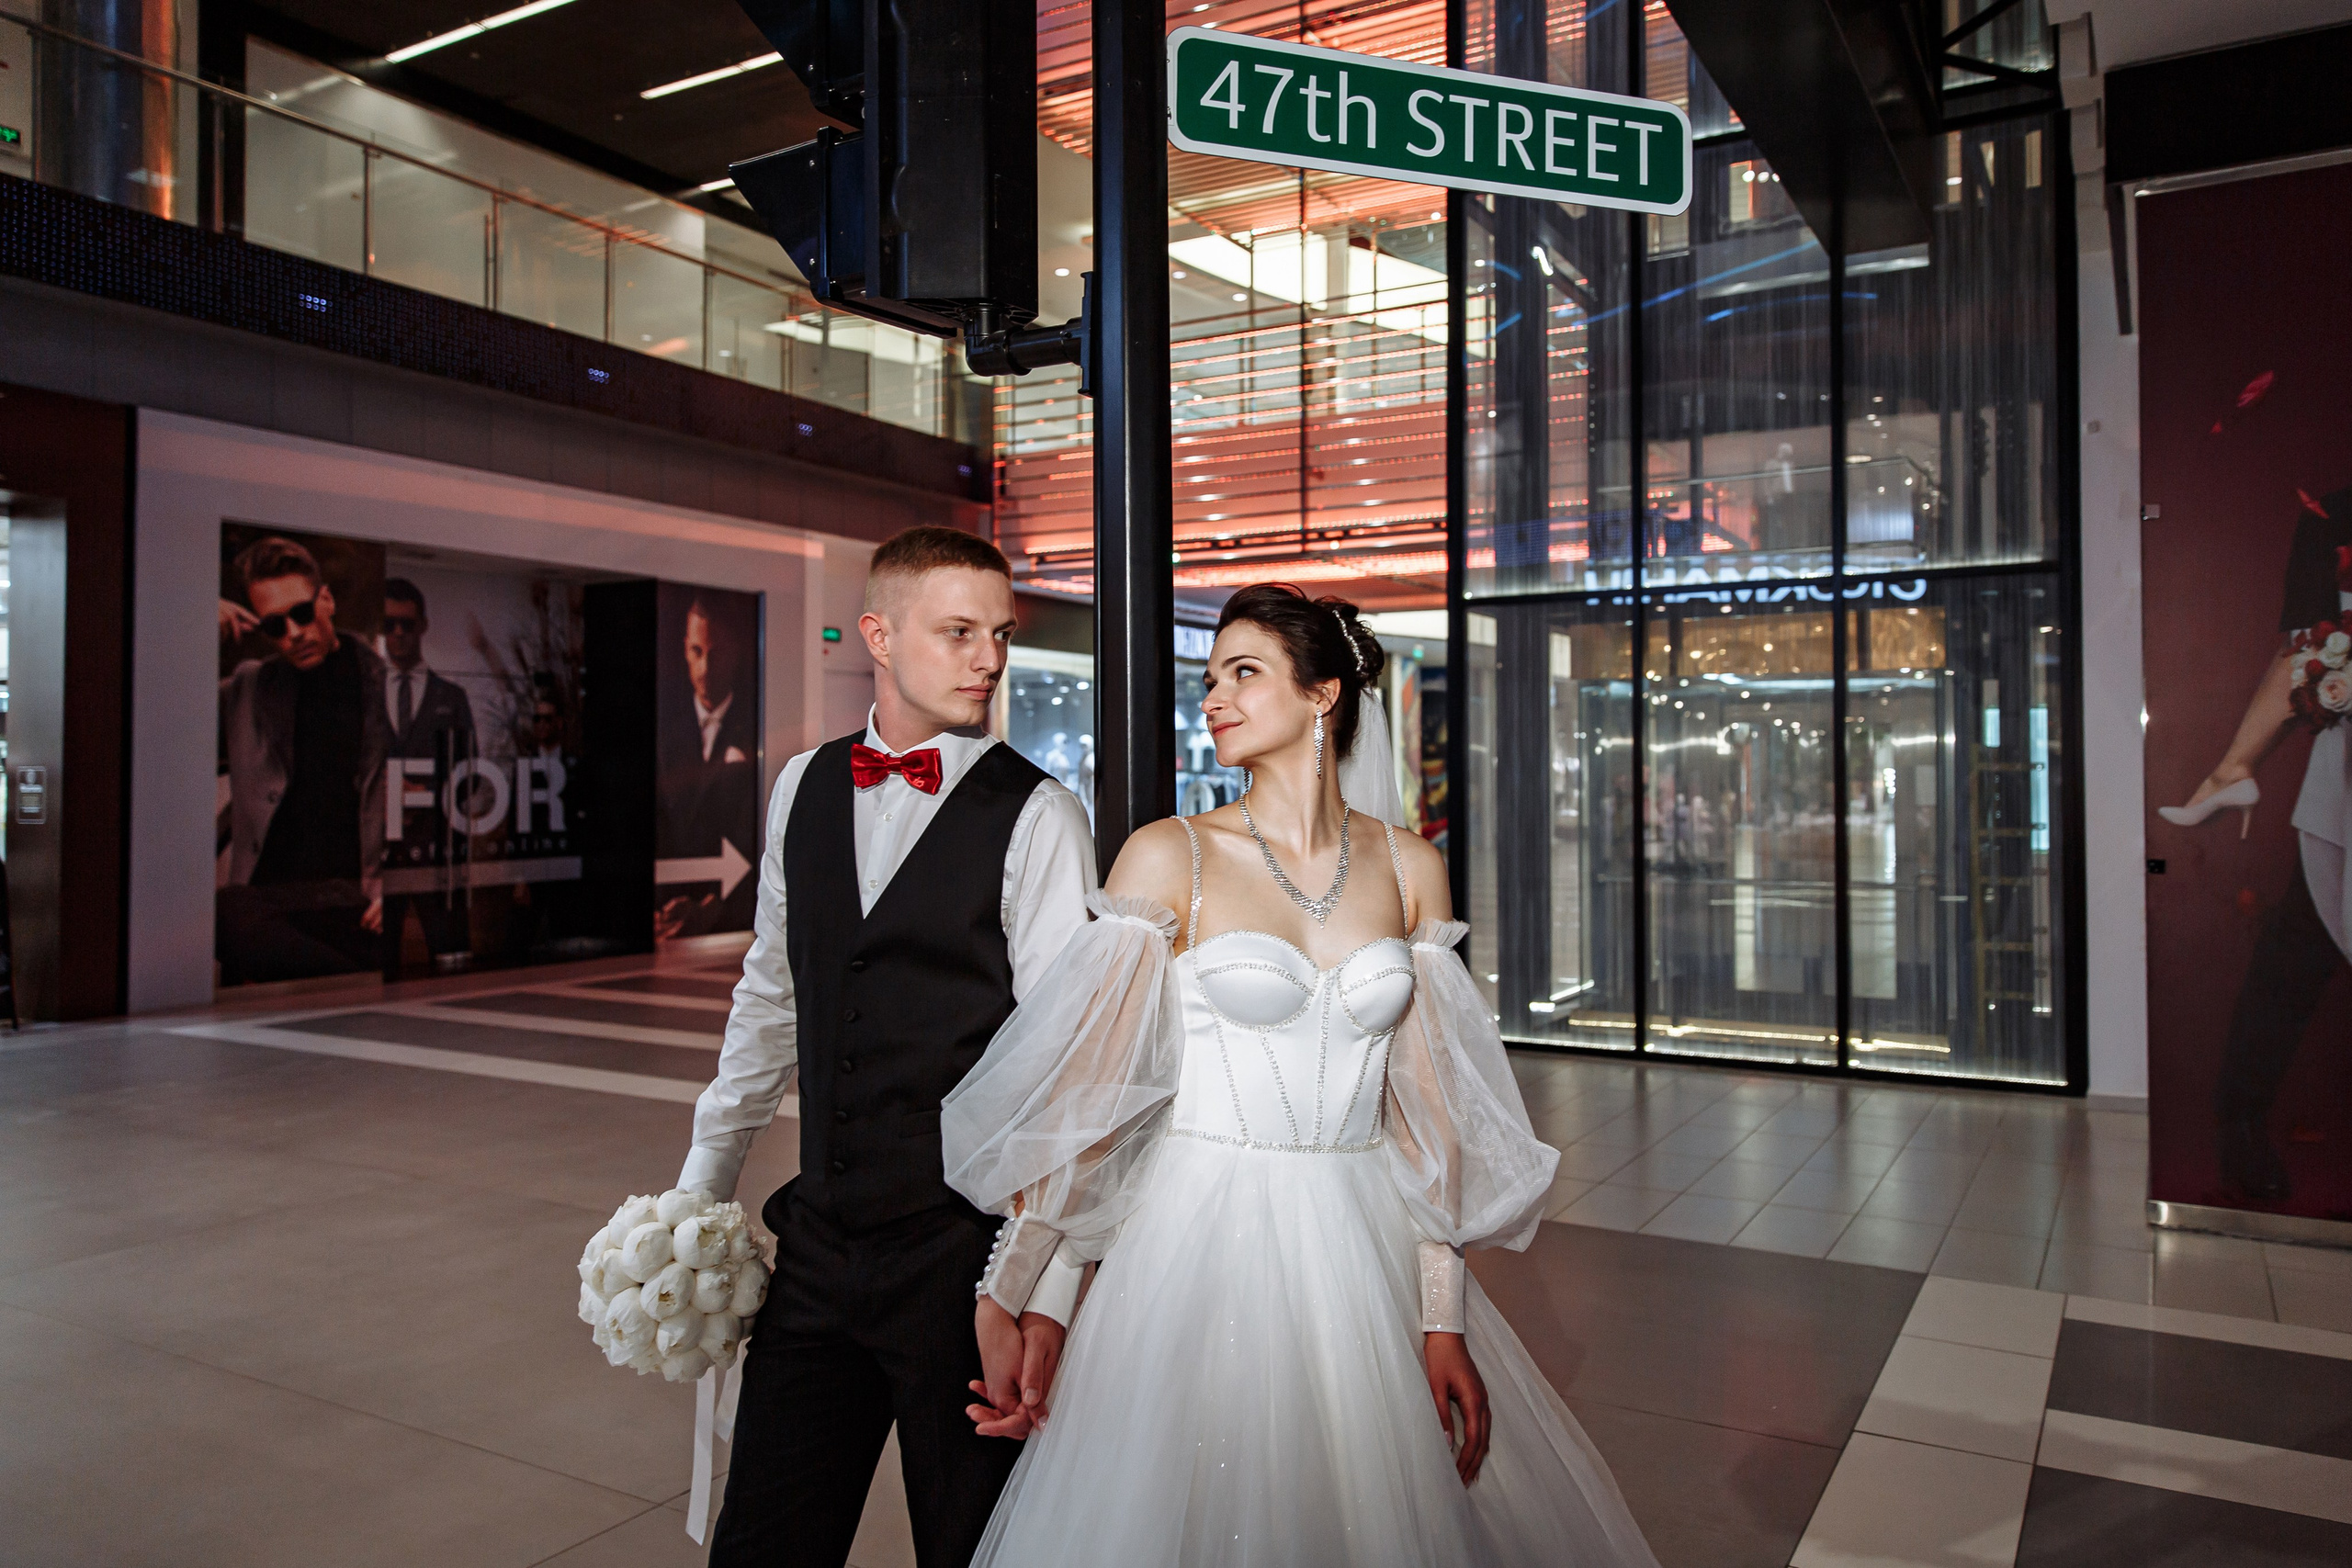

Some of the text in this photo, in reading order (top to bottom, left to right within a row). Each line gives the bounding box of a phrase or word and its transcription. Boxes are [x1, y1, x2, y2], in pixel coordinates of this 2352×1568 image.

[1200, 60, 1663, 186] 47th STREET
[386, 758, 566, 841] FOR
